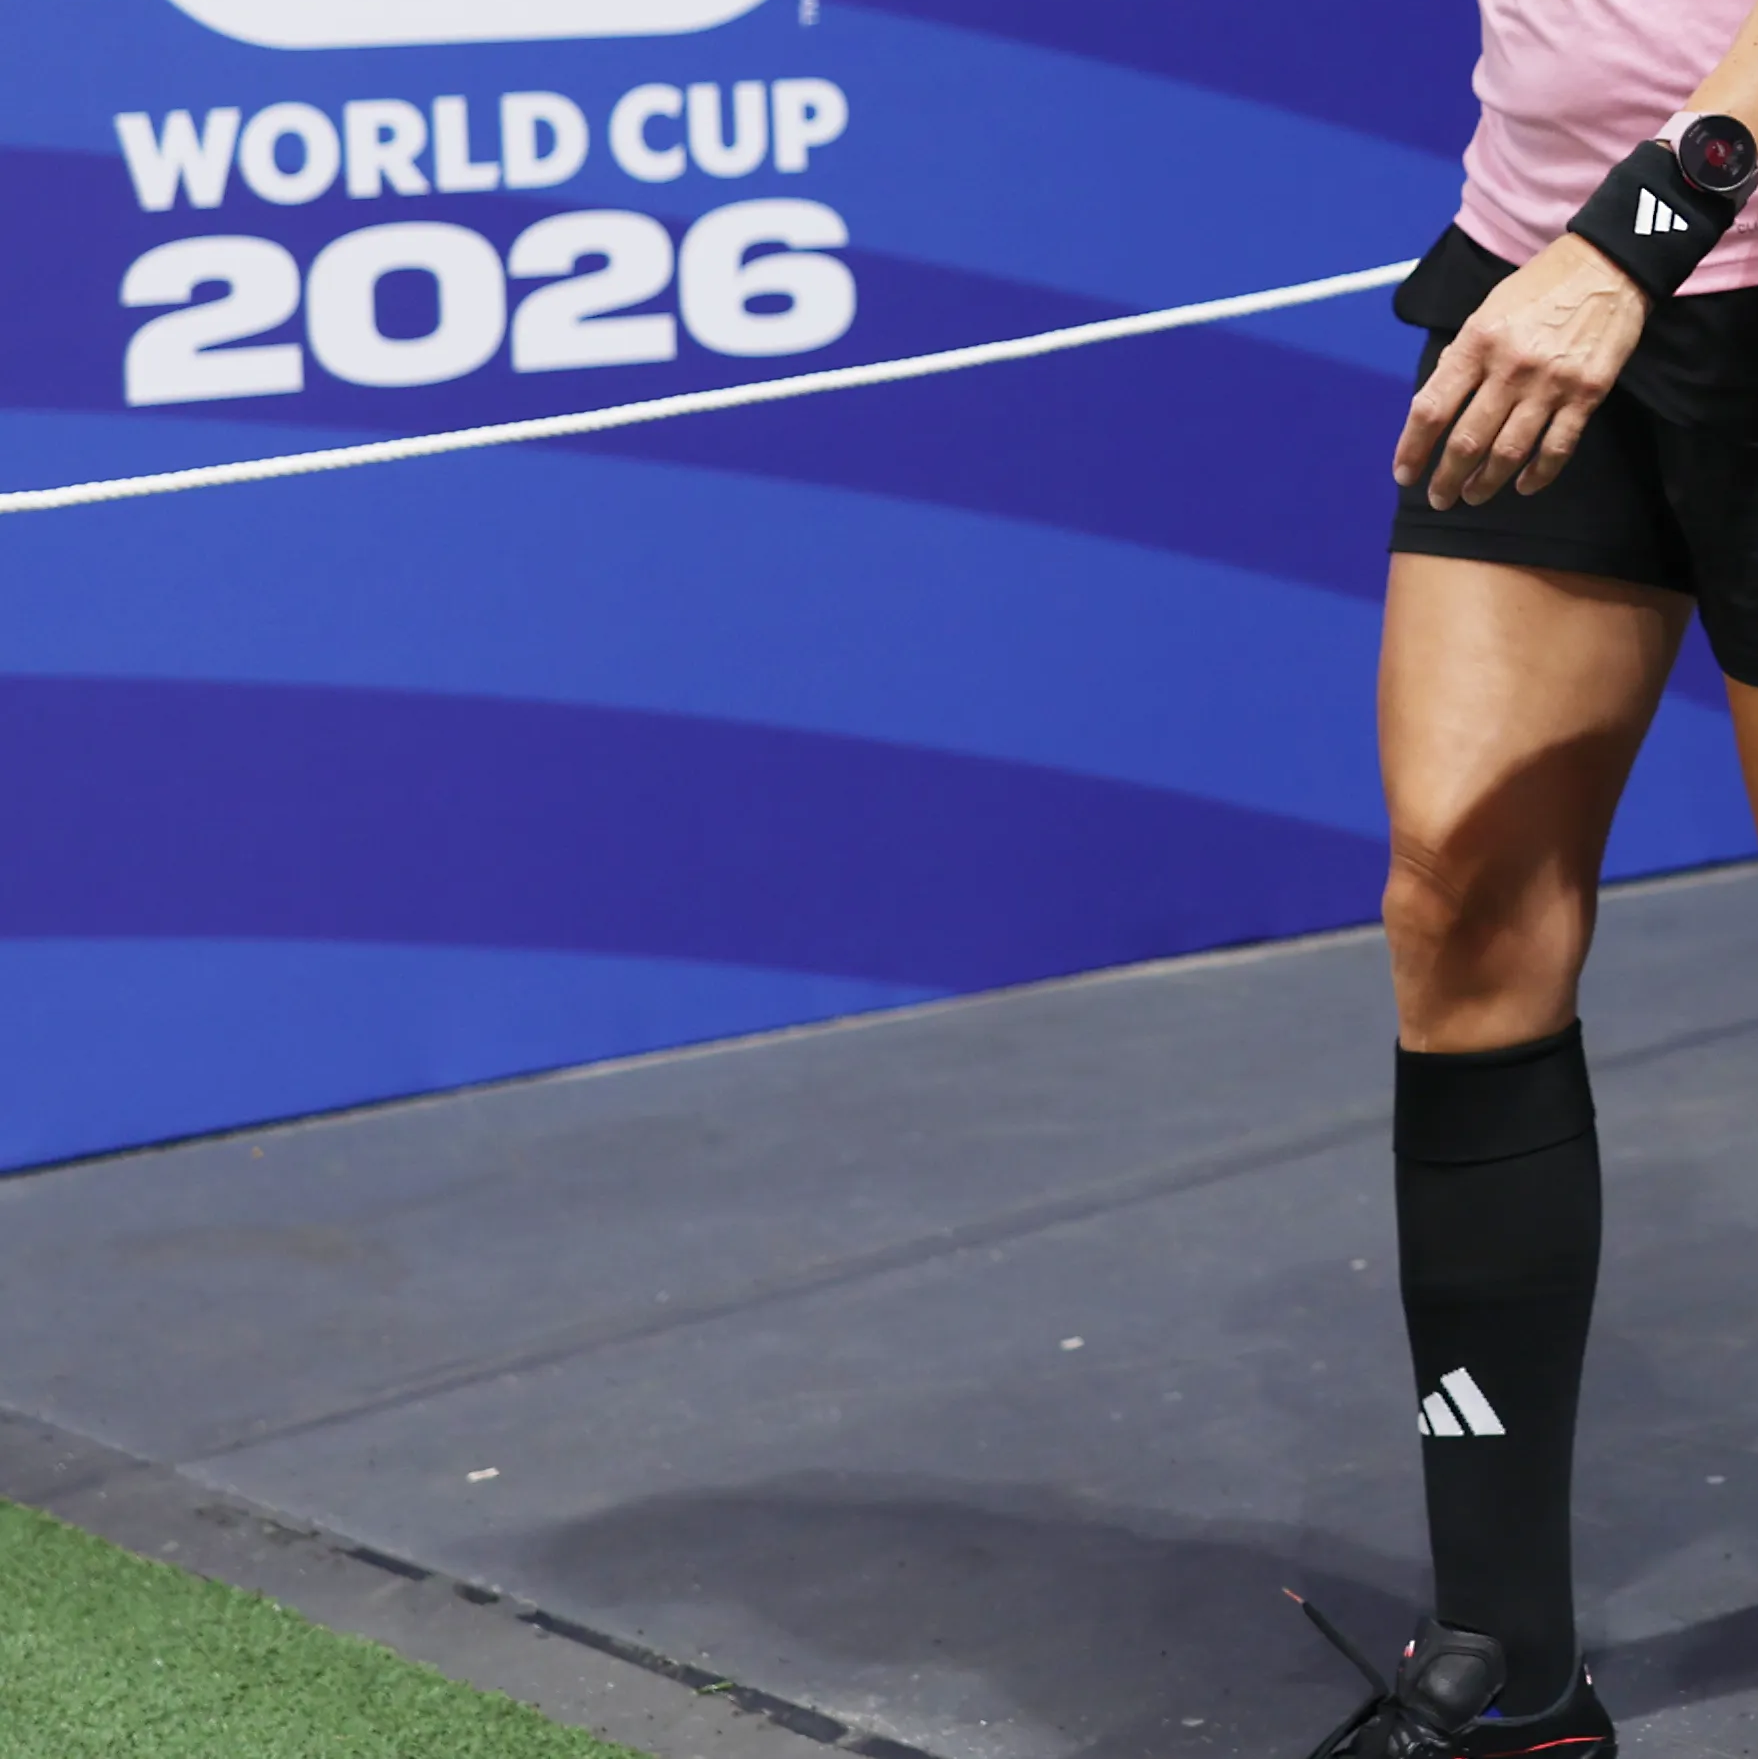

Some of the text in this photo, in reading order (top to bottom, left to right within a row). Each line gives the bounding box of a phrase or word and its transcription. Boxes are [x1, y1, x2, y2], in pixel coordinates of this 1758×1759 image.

[115, 78, 849, 212] WORLD CUP
[120, 198, 857, 407] 2026
